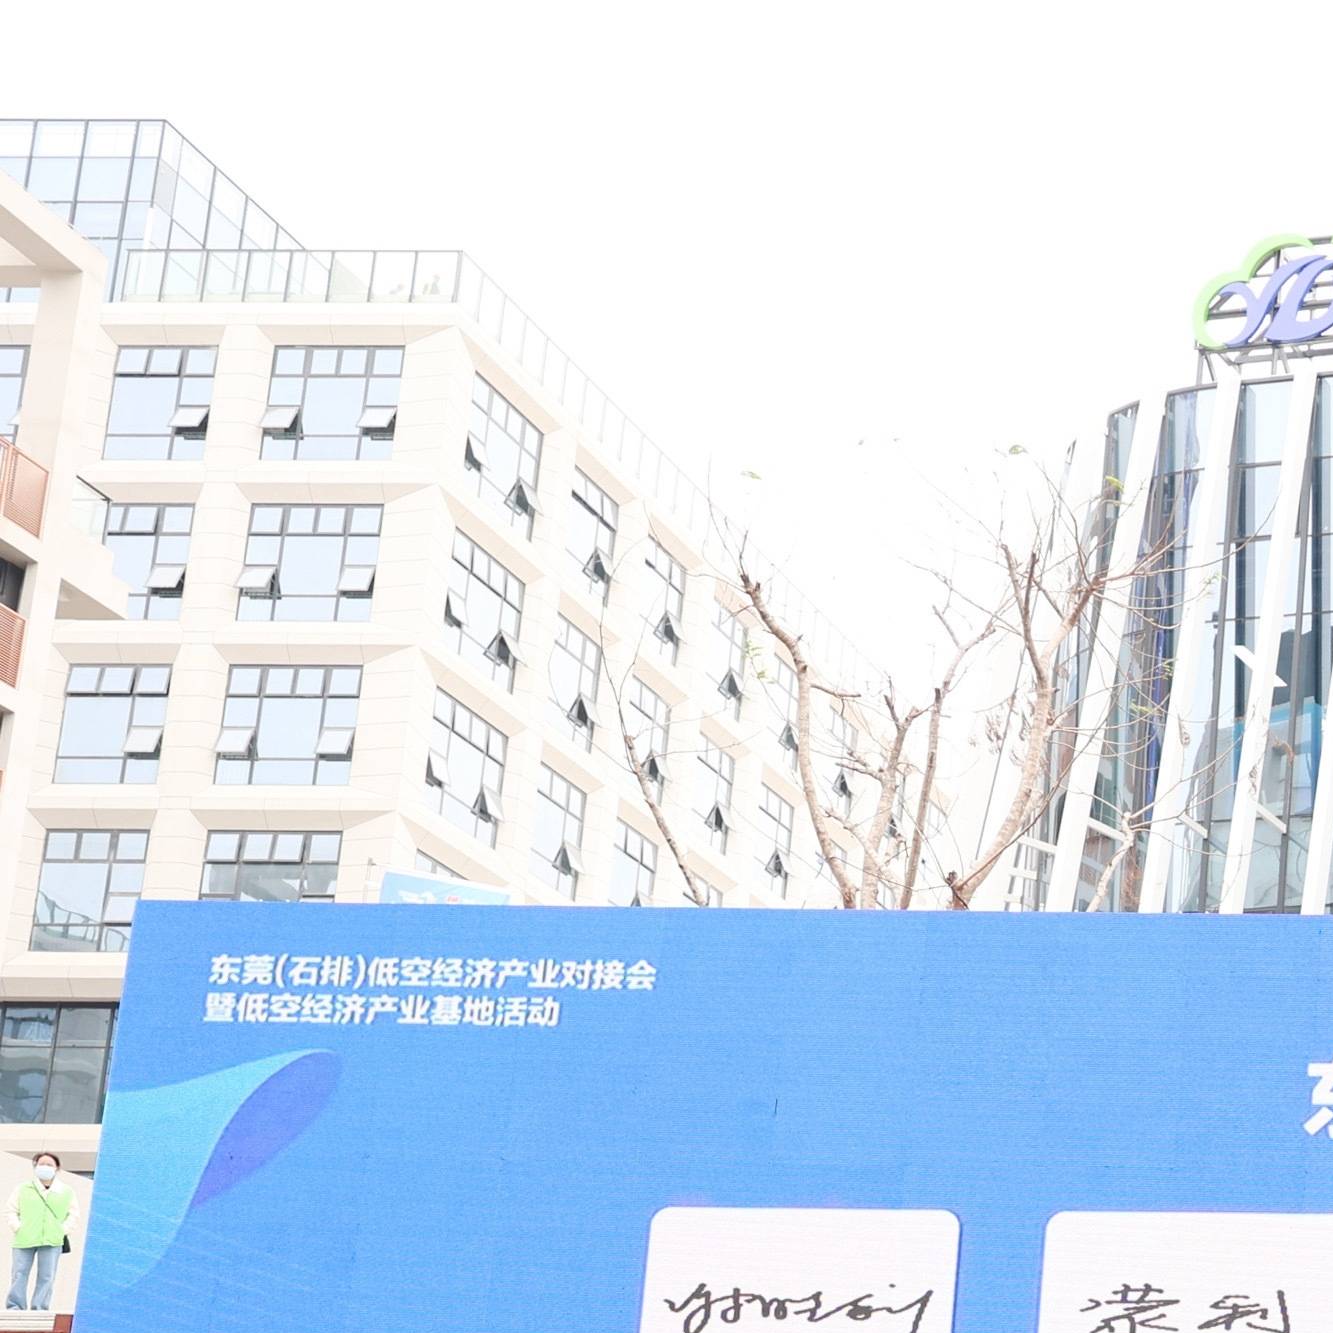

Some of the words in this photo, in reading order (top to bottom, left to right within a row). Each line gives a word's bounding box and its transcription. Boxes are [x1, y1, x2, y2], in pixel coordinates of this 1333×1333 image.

[208, 953, 657, 991] 东莞(石排)低空经济产业对接会
[203, 992, 561, 1027] 暨低空经济产业基地活动
